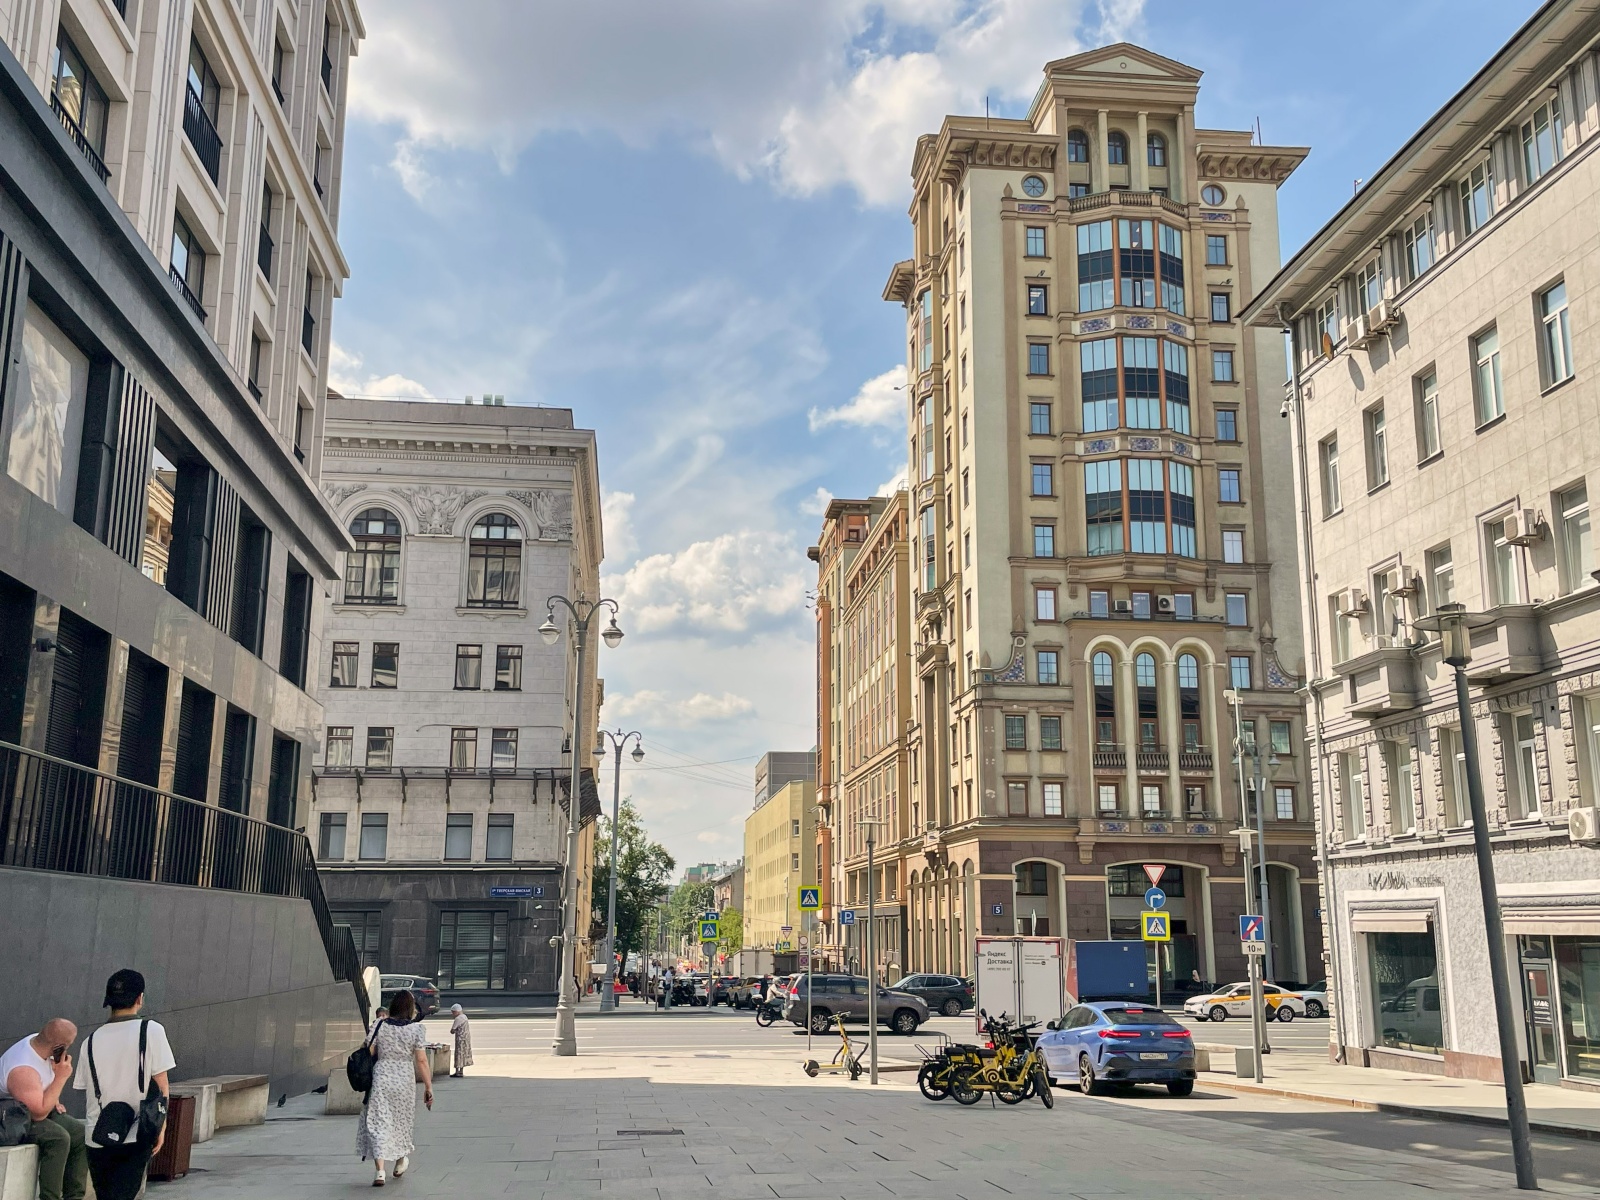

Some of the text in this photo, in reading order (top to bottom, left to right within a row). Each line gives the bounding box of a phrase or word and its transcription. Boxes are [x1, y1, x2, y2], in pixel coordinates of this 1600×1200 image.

[995, 906, 1001, 914] 5
[844, 911, 853, 924] P
[1246, 944, 1256, 952] 10
